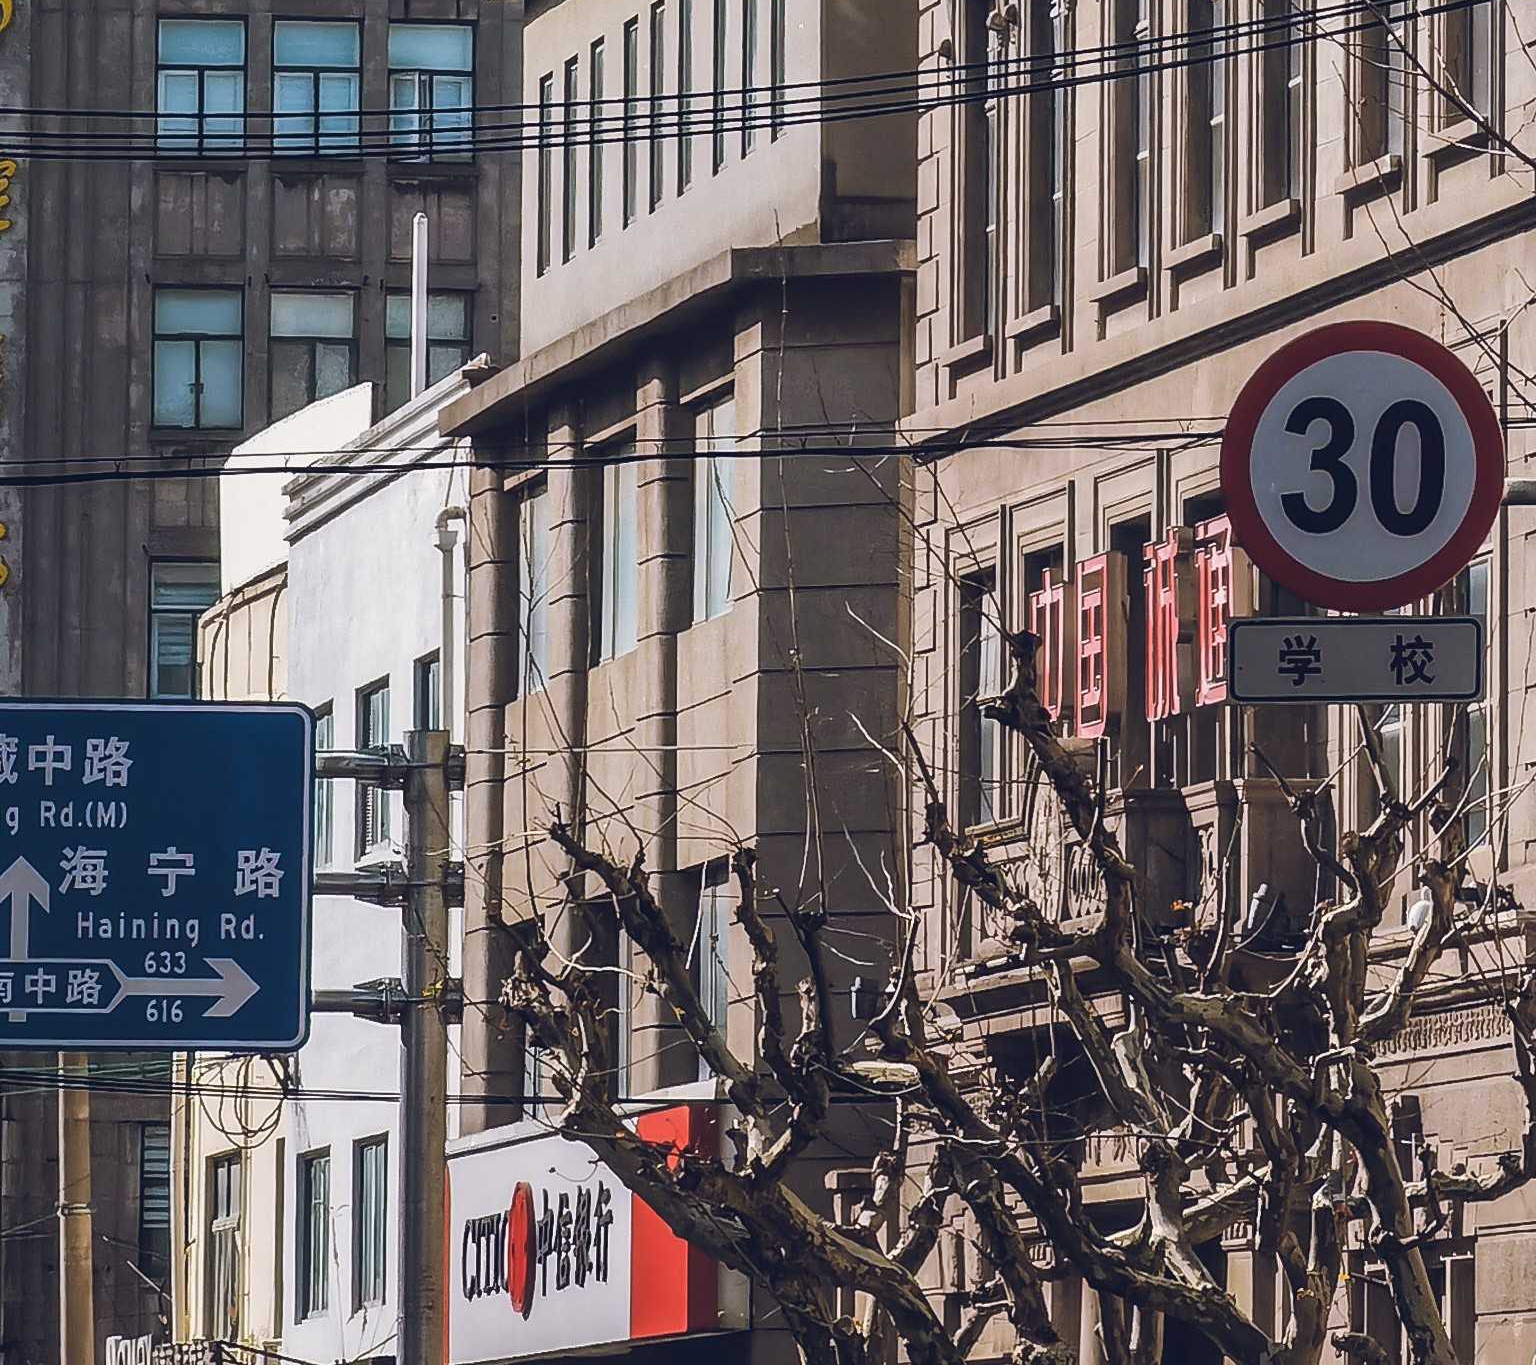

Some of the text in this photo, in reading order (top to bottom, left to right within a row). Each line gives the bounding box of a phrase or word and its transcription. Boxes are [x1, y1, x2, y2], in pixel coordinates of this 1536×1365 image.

[1280, 395, 1446, 538] 30
[1278, 634, 1436, 686] 学校
[40, 800, 127, 829] Rd.(M)
[58, 845, 285, 899] 海宁路
[76, 912, 264, 947] Haining Rd.
[144, 951, 187, 975] 633
[146, 999, 184, 1024] 616
